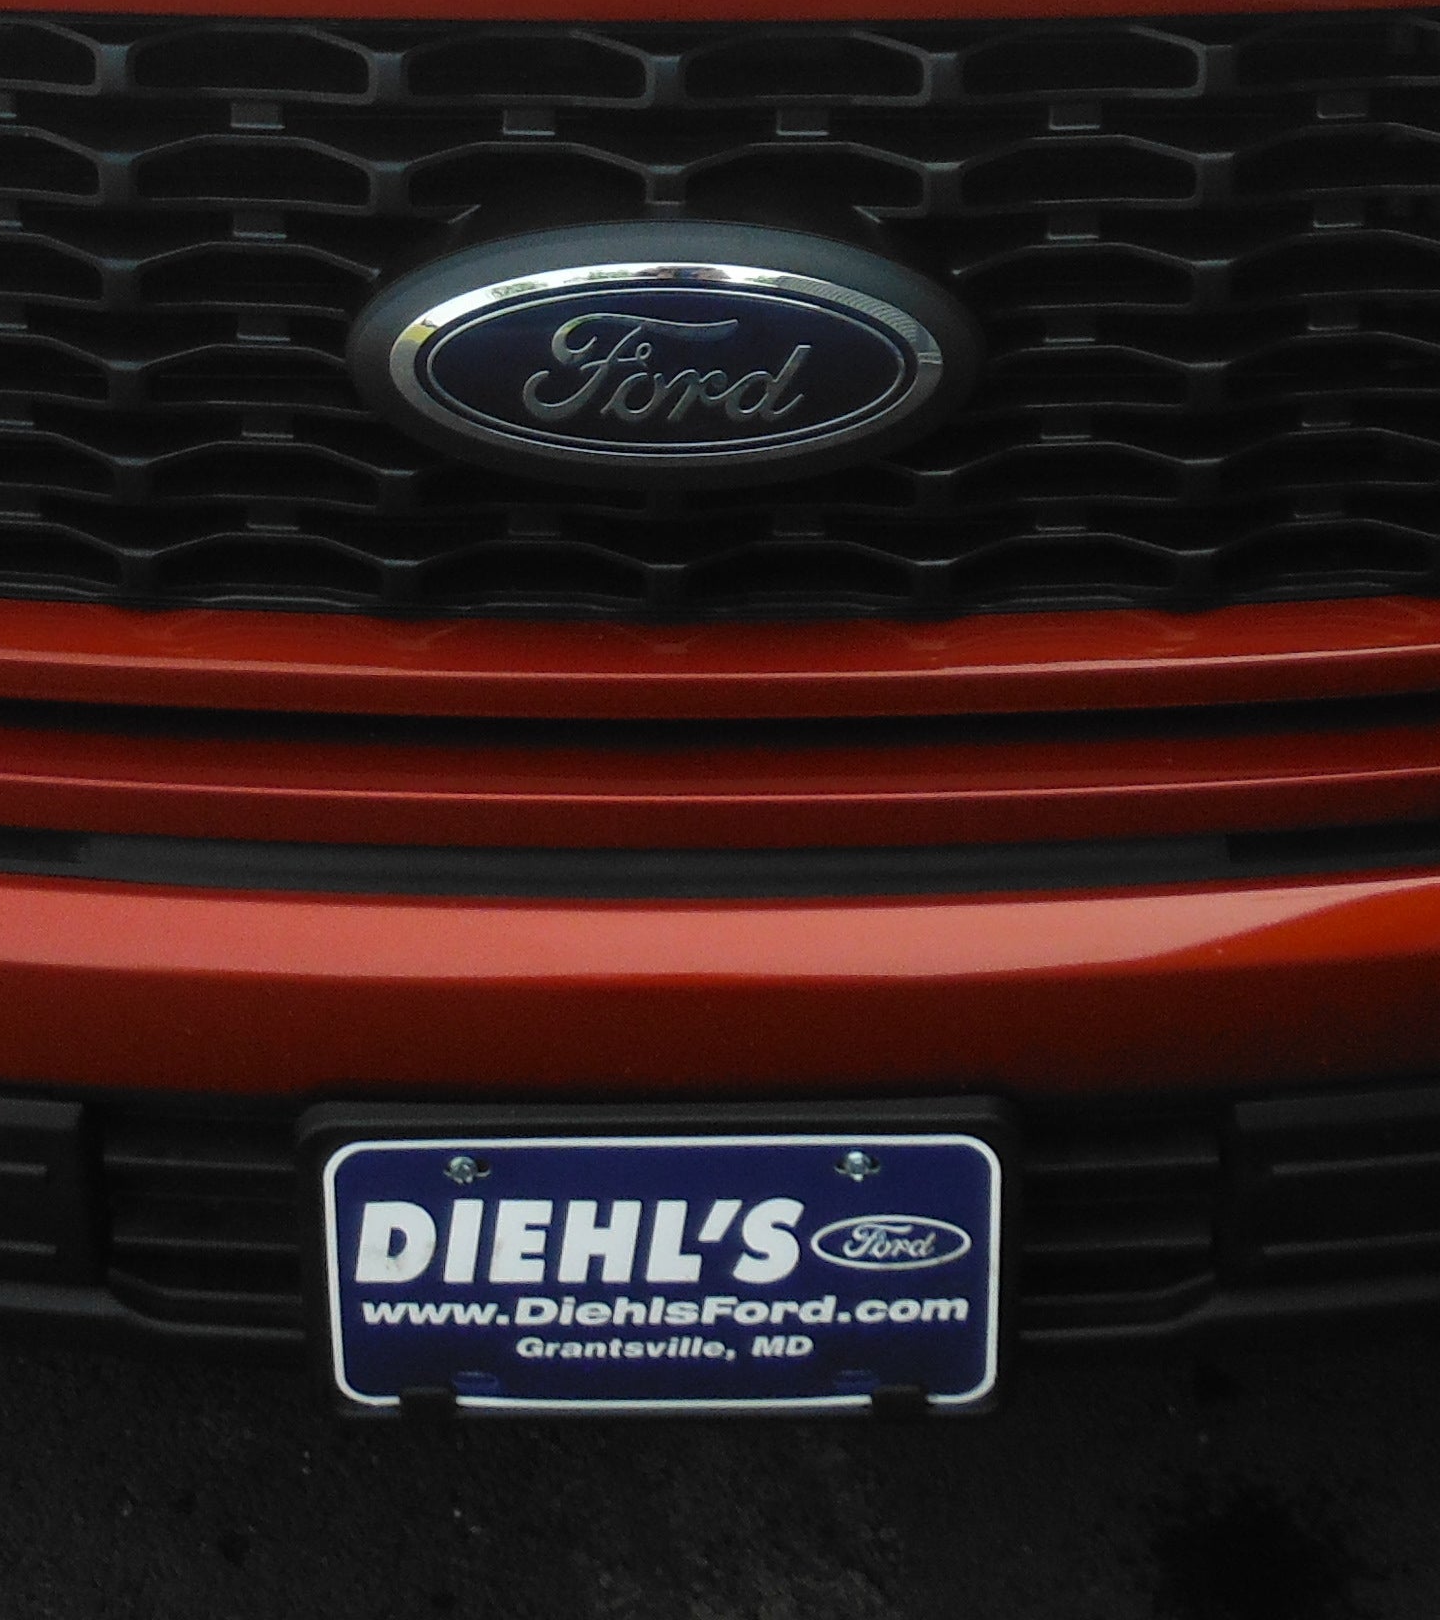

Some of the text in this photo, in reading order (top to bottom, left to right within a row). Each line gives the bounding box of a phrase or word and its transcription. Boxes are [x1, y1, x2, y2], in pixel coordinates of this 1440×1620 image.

[522, 312, 812, 422] Ford
[354, 1197, 806, 1285] DIEHL'S
[842, 1223, 936, 1259] Ford
[361, 1294, 969, 1327] www.DiehlsFord.com
[515, 1335, 815, 1361] Grantsville, MD
